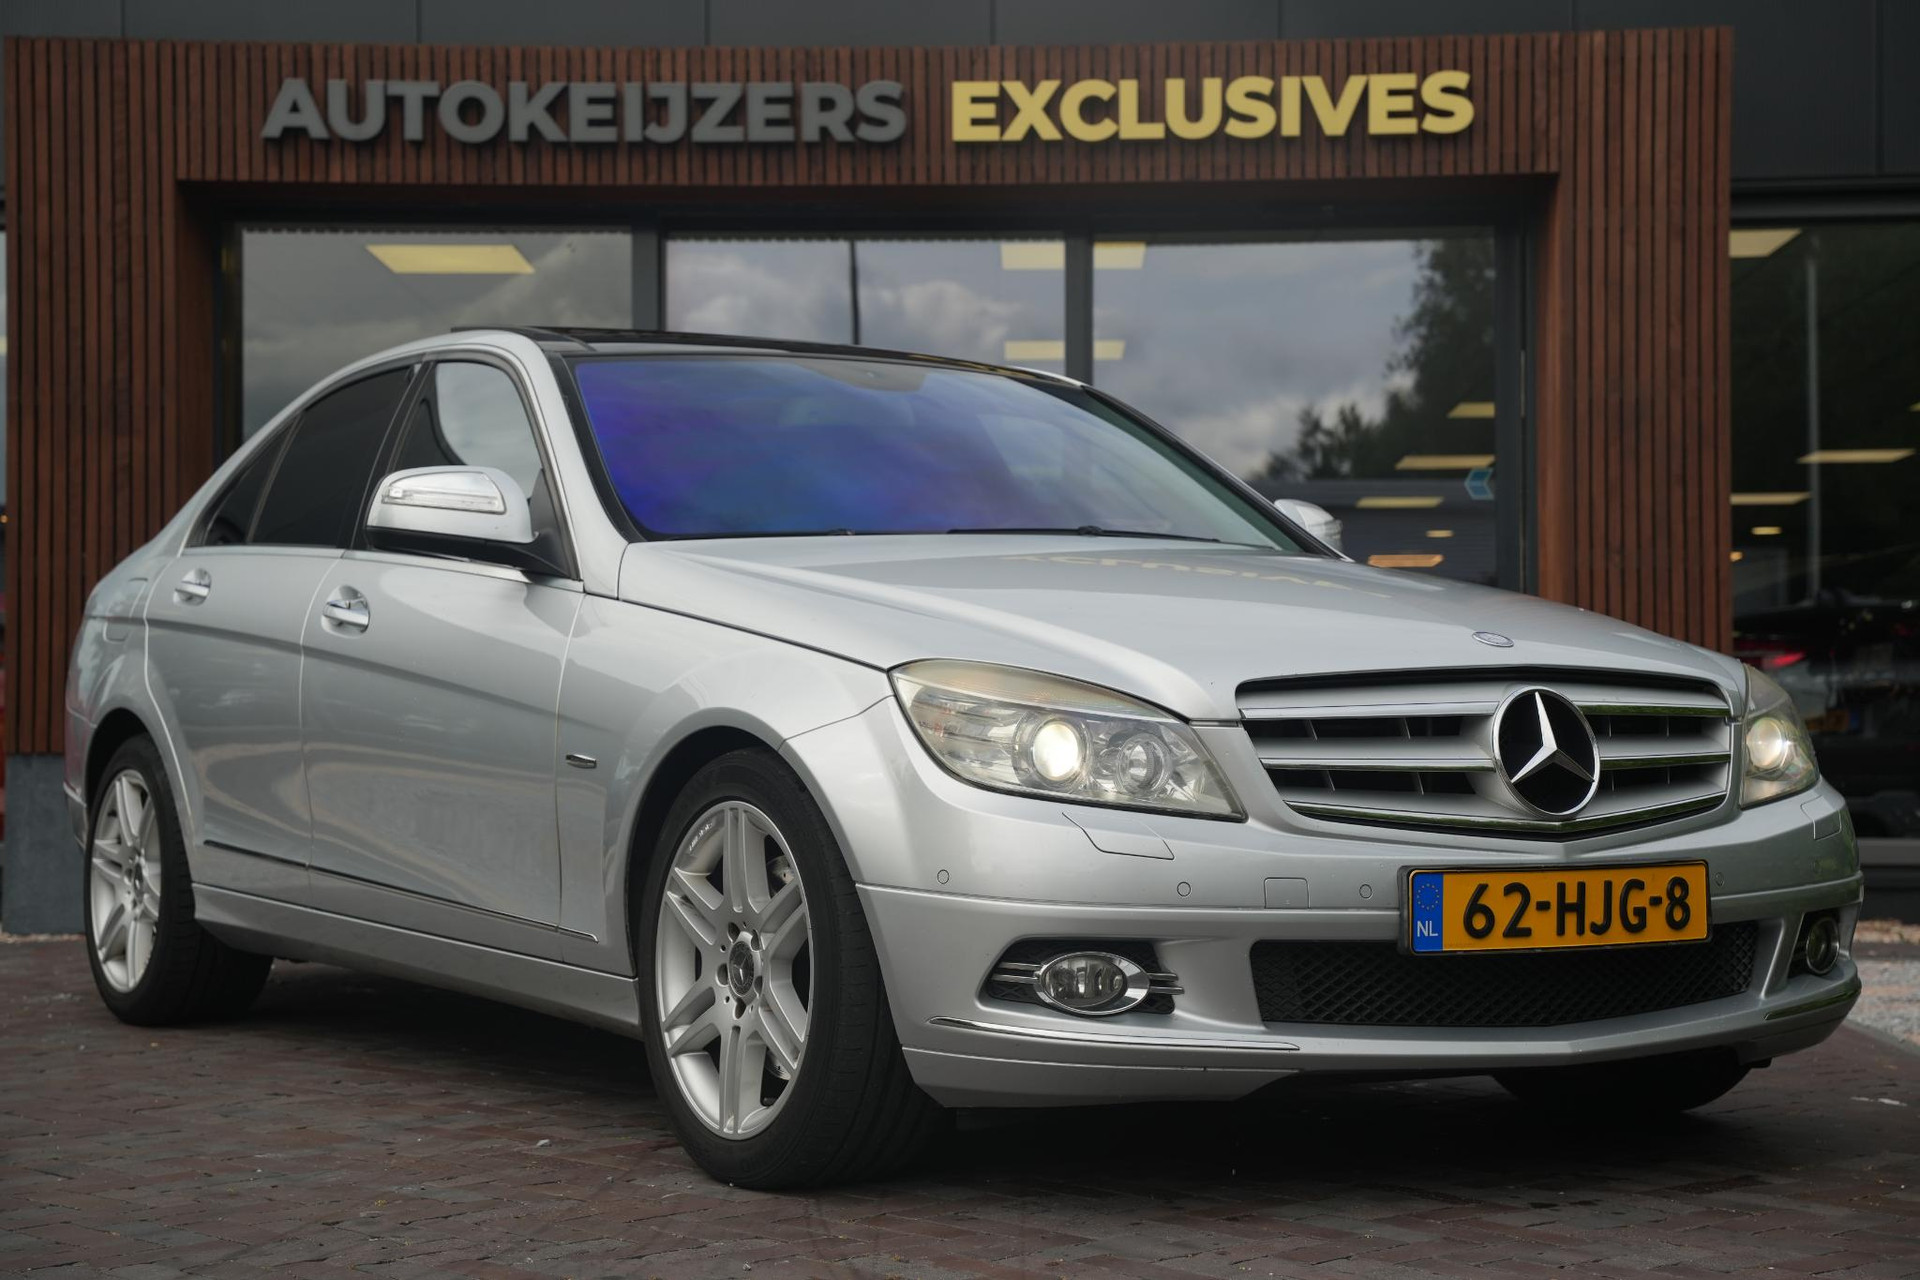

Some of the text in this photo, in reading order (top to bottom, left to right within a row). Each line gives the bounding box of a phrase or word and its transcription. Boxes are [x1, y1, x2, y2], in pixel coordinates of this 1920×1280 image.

[261, 70, 1475, 144] AUTOKEIJZERS EXCLUSIVES
[1416, 920, 1439, 937] NL
[1463, 876, 1692, 939] 62-HJG-8
